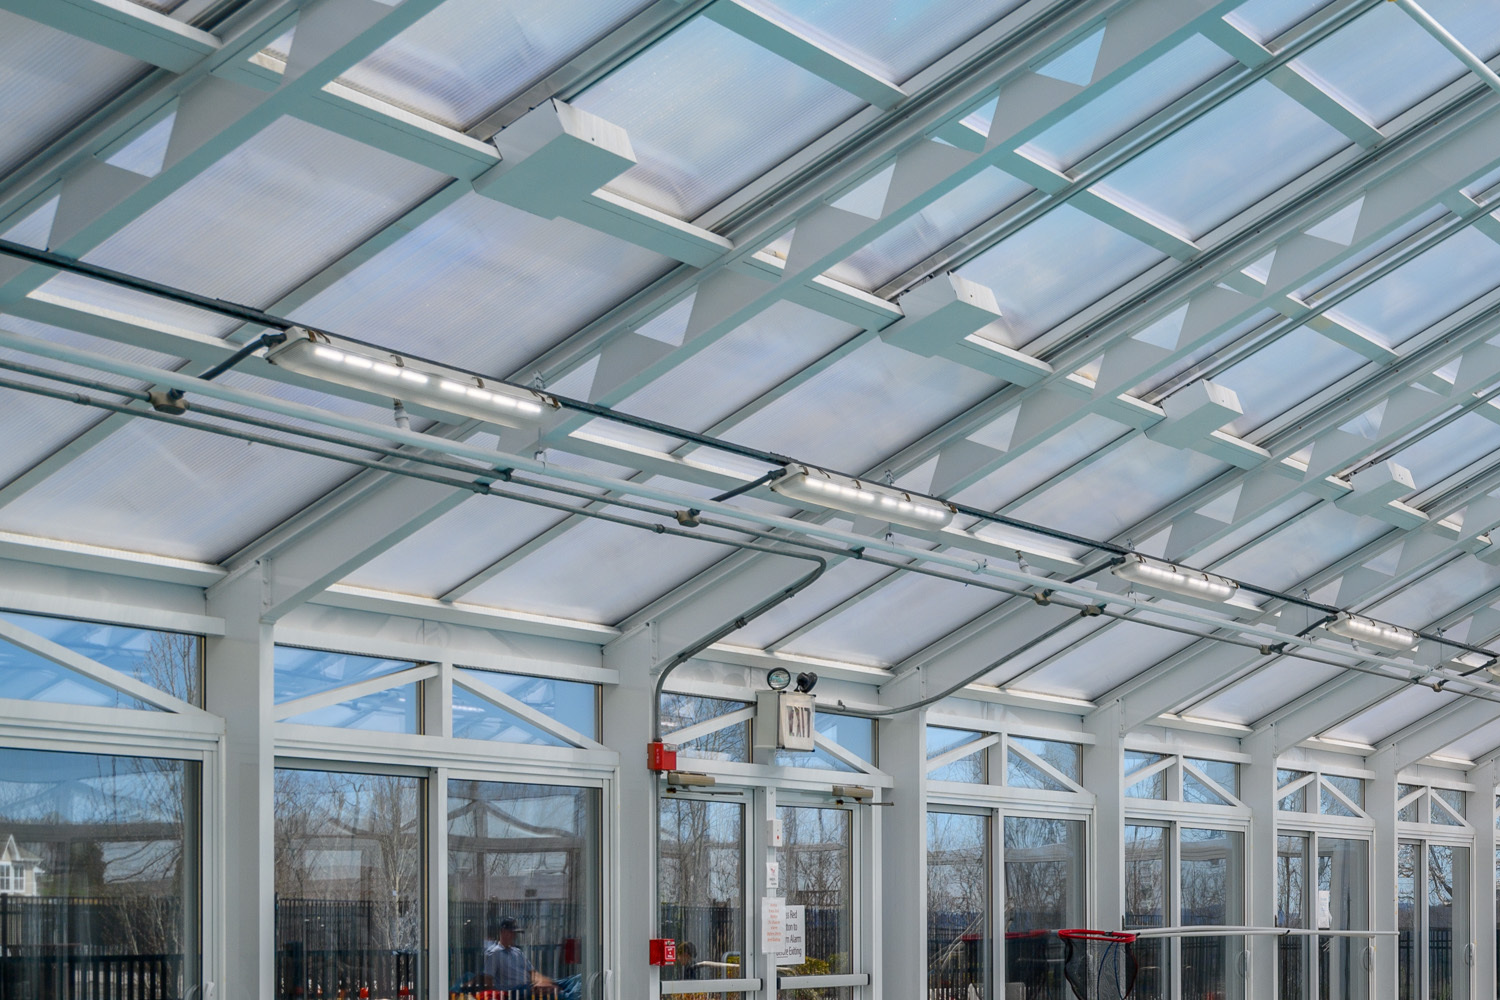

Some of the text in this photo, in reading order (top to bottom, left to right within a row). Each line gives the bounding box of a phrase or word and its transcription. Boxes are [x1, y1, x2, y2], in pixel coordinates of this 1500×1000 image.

[786, 705, 811, 738] EXIT
[790, 909, 798, 919] Red
[790, 934, 802, 943] Alarm
[789, 947, 802, 957] Exiting
